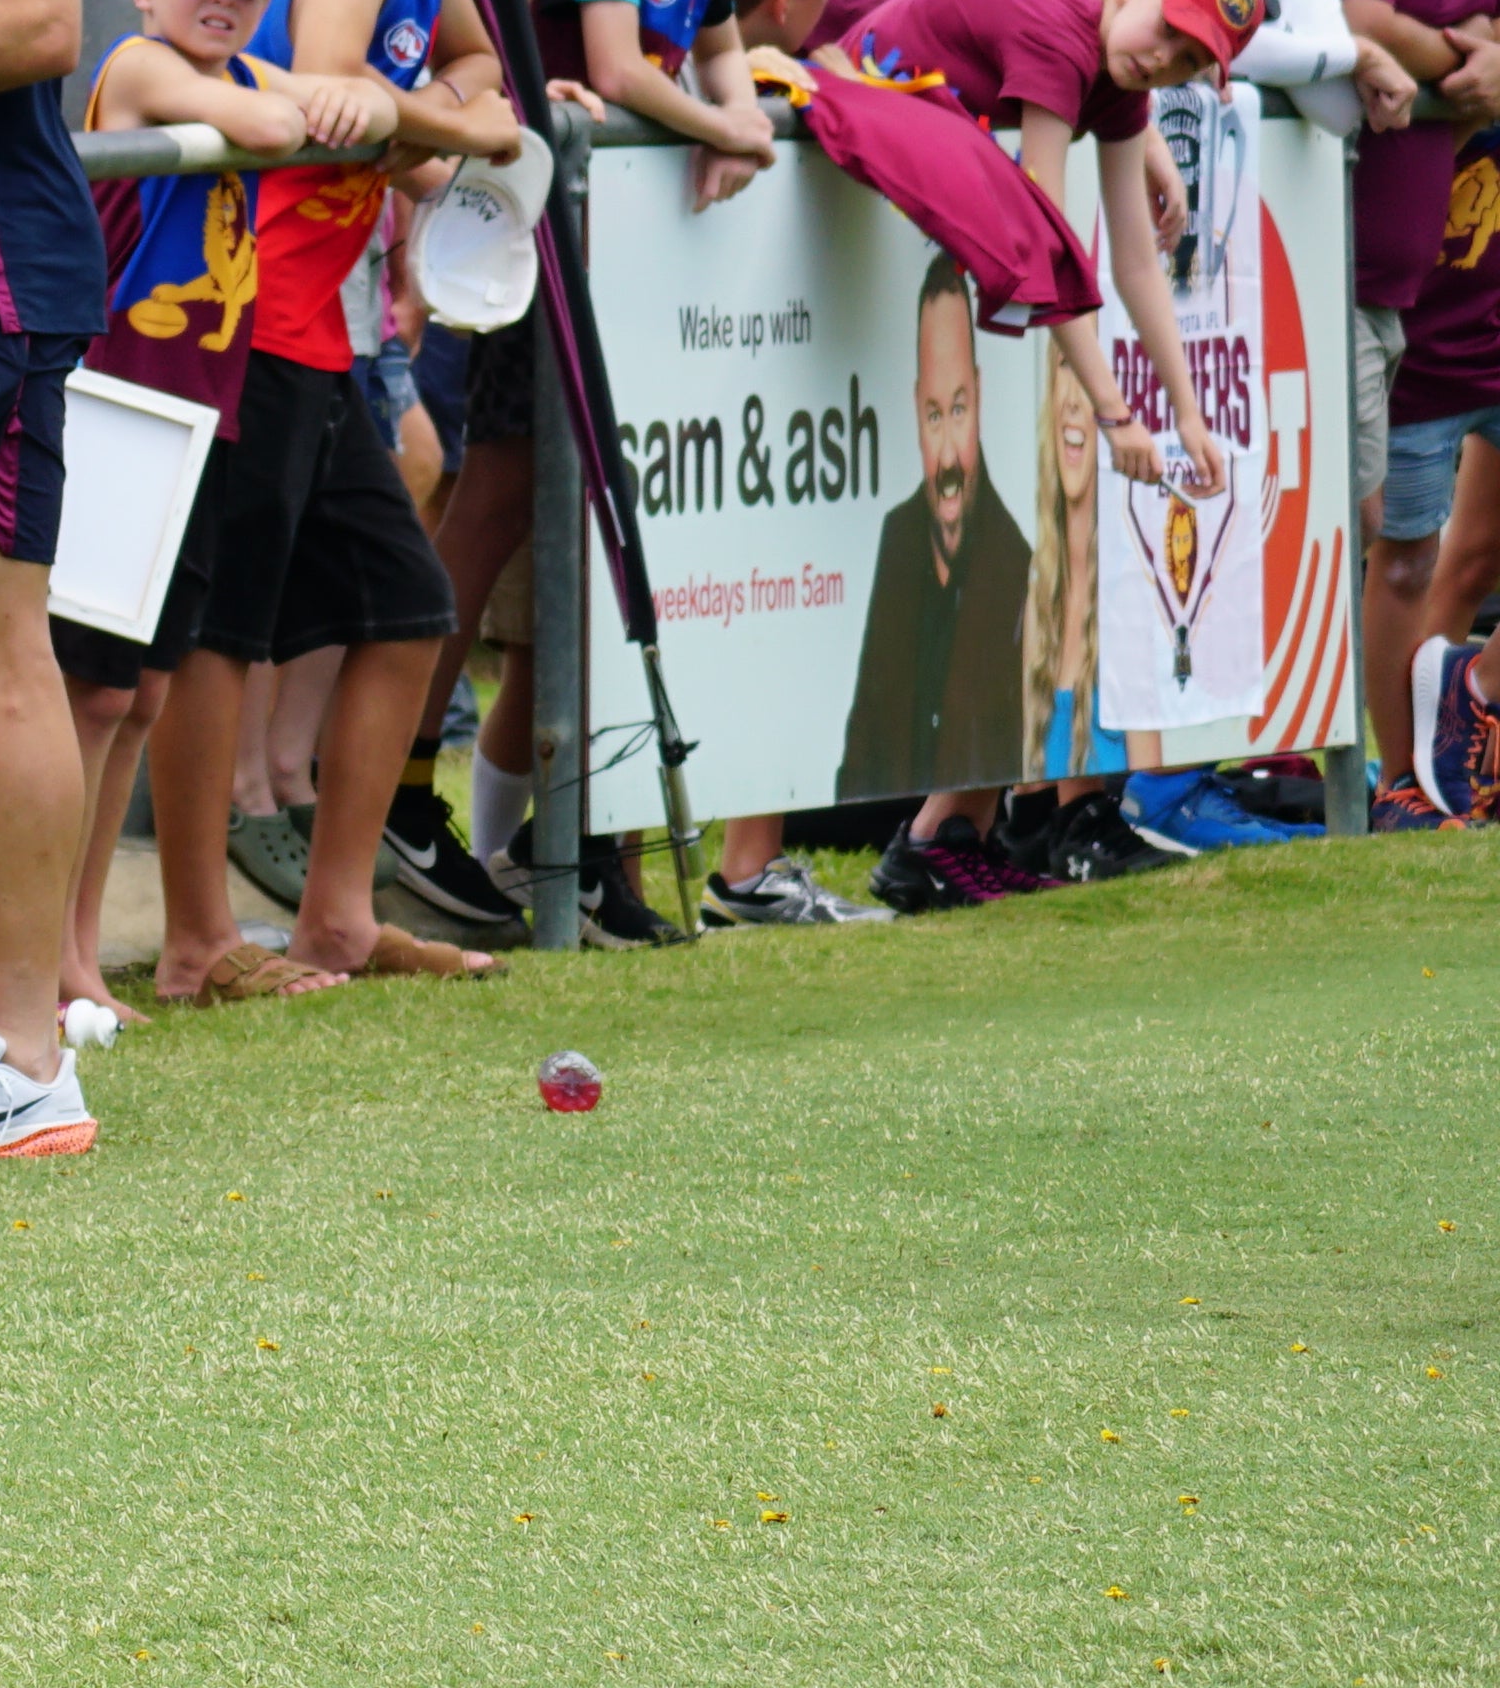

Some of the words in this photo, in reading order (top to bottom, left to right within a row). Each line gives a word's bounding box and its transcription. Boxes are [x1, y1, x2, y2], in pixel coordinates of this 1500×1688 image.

[679, 305, 733, 353] Wake
[739, 312, 764, 359] up
[768, 299, 812, 348] with
[737, 393, 776, 510] &
[787, 373, 881, 508] ash
[652, 572, 747, 629] weekdays
[750, 567, 796, 615] from
[799, 563, 846, 610] 5am
